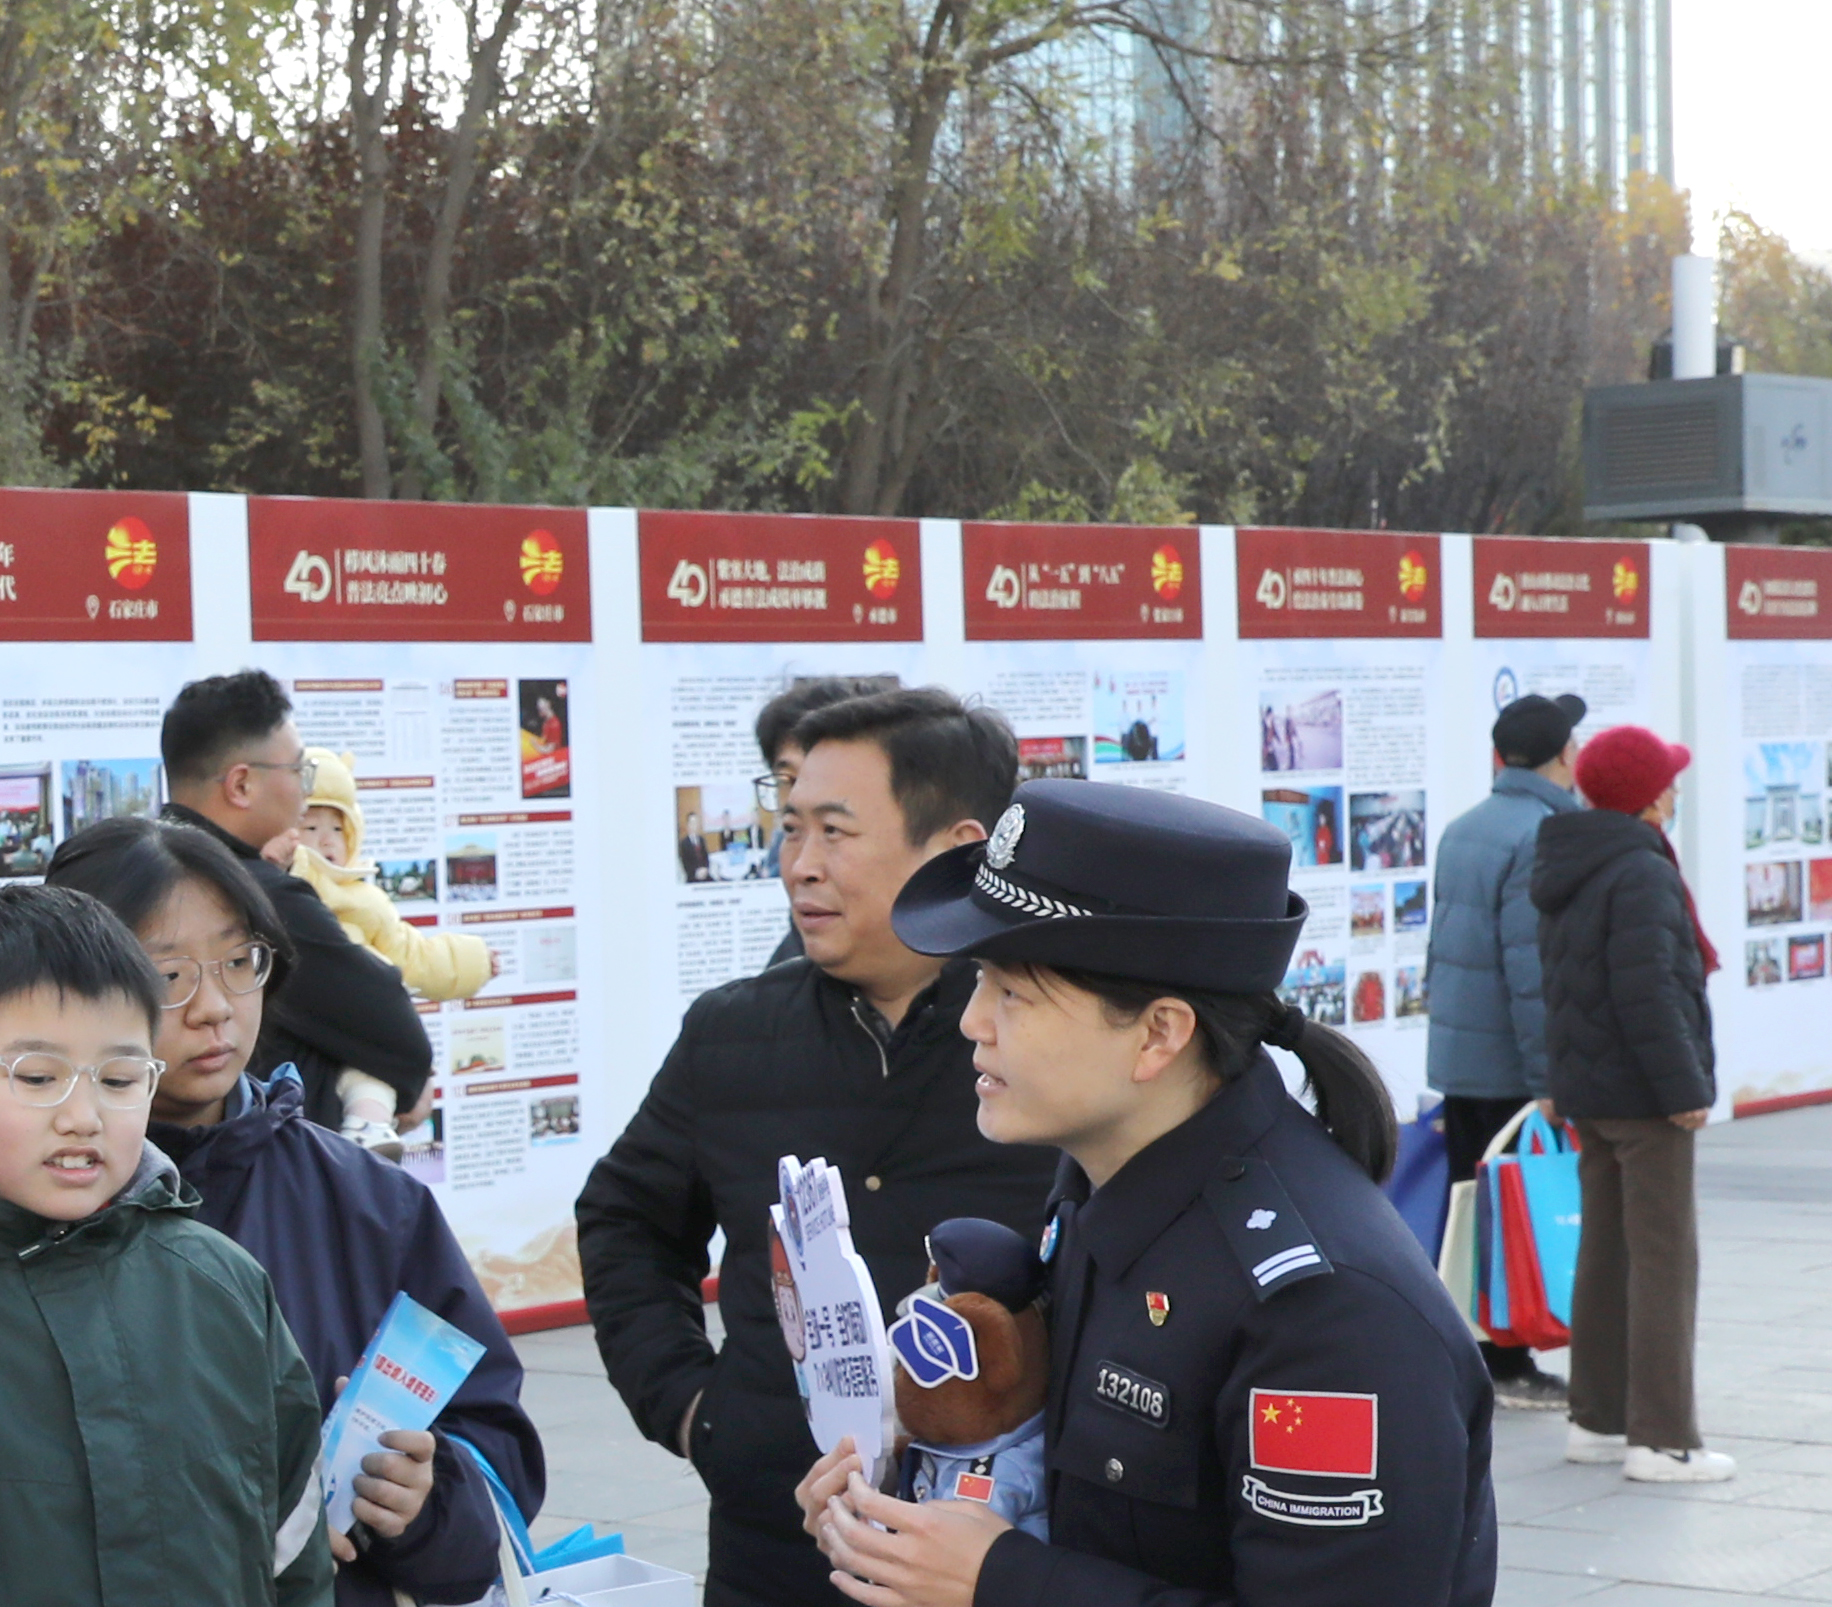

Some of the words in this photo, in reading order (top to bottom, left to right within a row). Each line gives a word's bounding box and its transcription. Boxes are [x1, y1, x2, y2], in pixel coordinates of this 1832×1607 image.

[108, 599, 159, 621] 石家庄市
[1096, 1368, 1163, 1419] 132108
[1257, 1495, 1288, 1512] CHINA
[1289, 1503, 1361, 1517] IMMIGRATION
